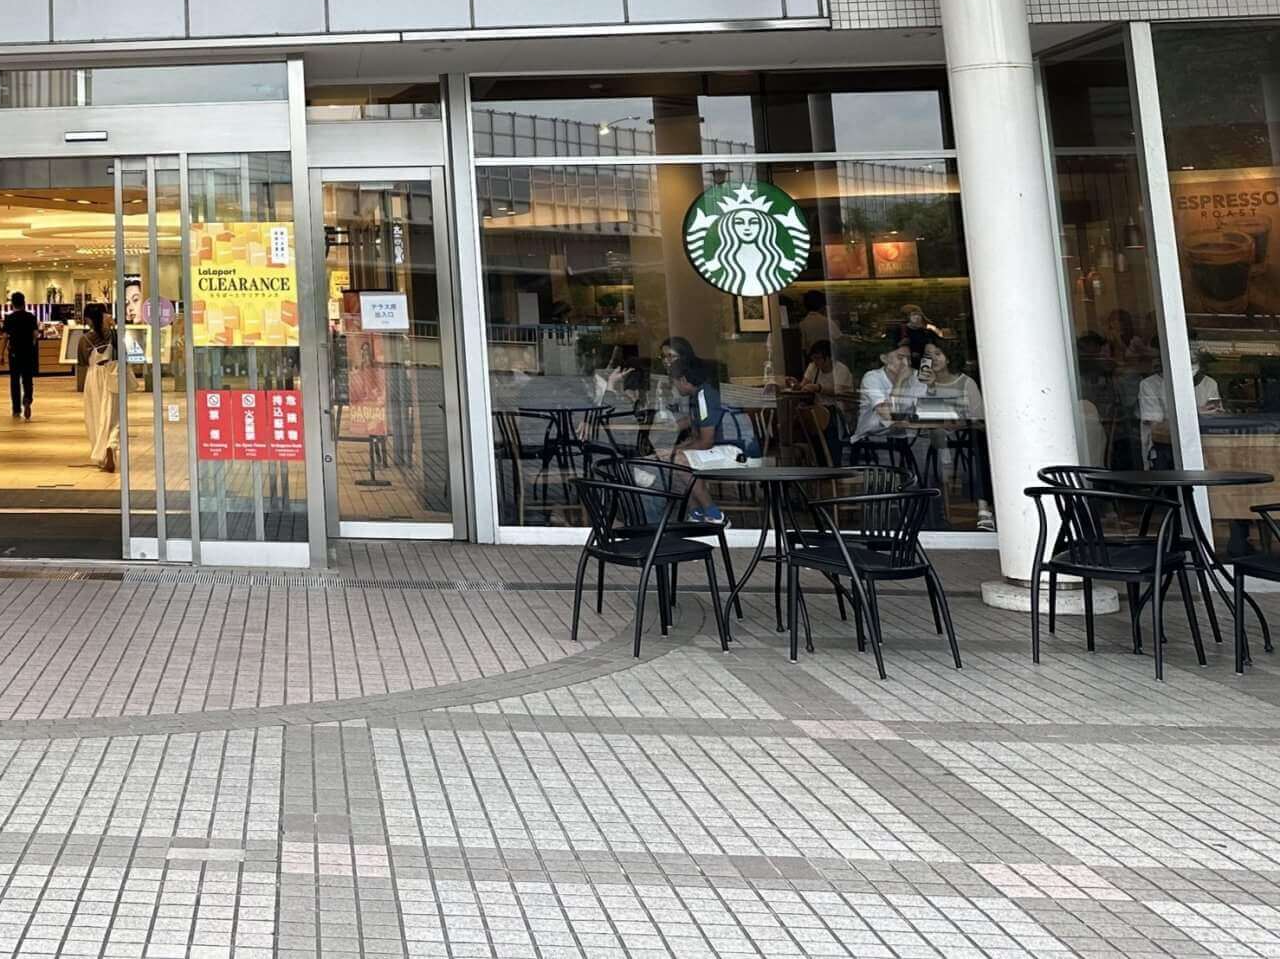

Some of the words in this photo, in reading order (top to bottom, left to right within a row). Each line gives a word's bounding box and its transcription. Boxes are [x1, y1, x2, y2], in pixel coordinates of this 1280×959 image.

[1175, 191, 1279, 210] ESPRESSO
[1201, 209, 1257, 218] ROAST
[198, 268, 236, 277] LaLaport
[198, 277, 291, 292] CLEARANCE
